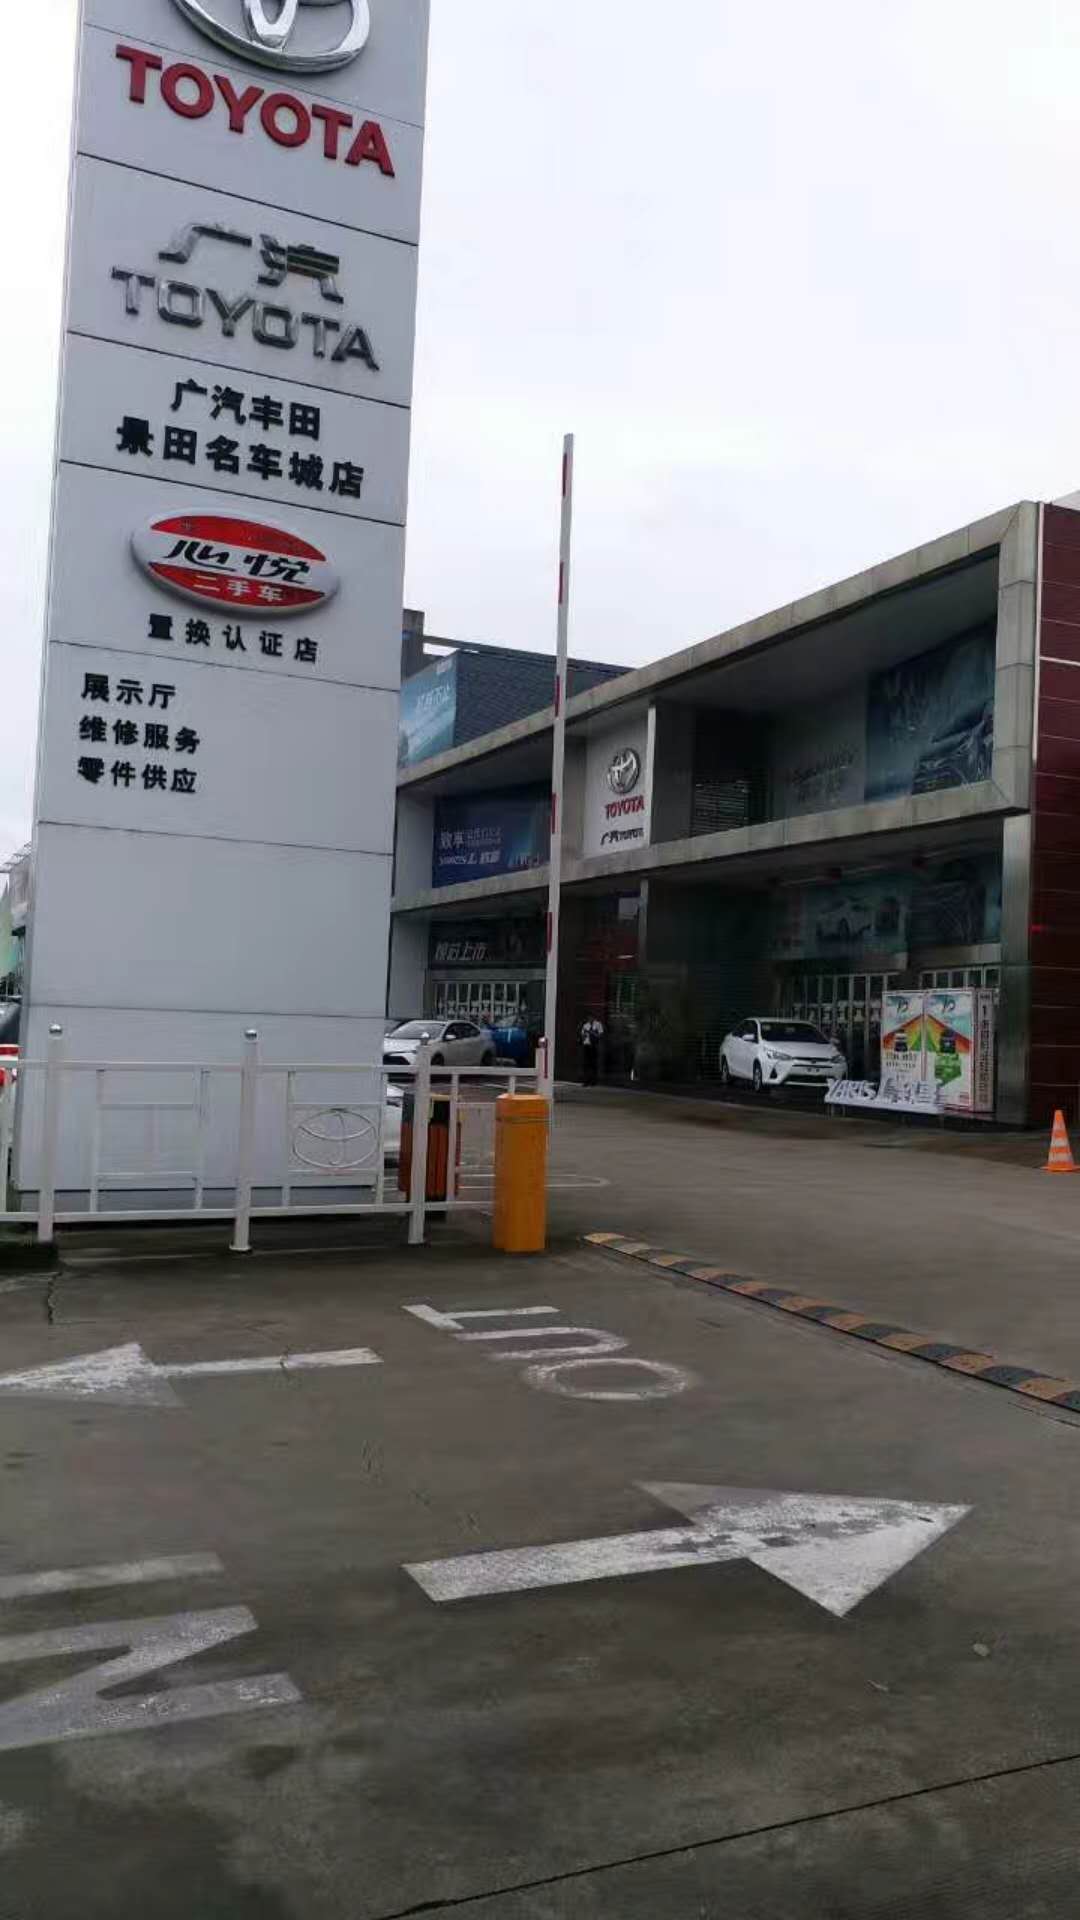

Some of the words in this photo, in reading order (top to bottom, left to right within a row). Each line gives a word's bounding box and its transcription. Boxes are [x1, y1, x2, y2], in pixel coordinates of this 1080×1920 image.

[115, 43, 396, 178] TOYOTA
[157, 221, 344, 304] 广汽
[110, 265, 380, 371] TOYOTA
[170, 378, 321, 441] 广汽丰田
[116, 415, 365, 498] 景田名车城店
[162, 539, 311, 585] 心悦
[193, 574, 283, 603] 二手车
[148, 613, 318, 664] 置换认证店
[81, 672, 176, 709] 展示厅
[78, 715, 200, 754] 维修服务
[77, 756, 197, 794] 零件供应
[604, 794, 645, 820] TOYOTA
[399, 1302, 698, 1402] OUT
